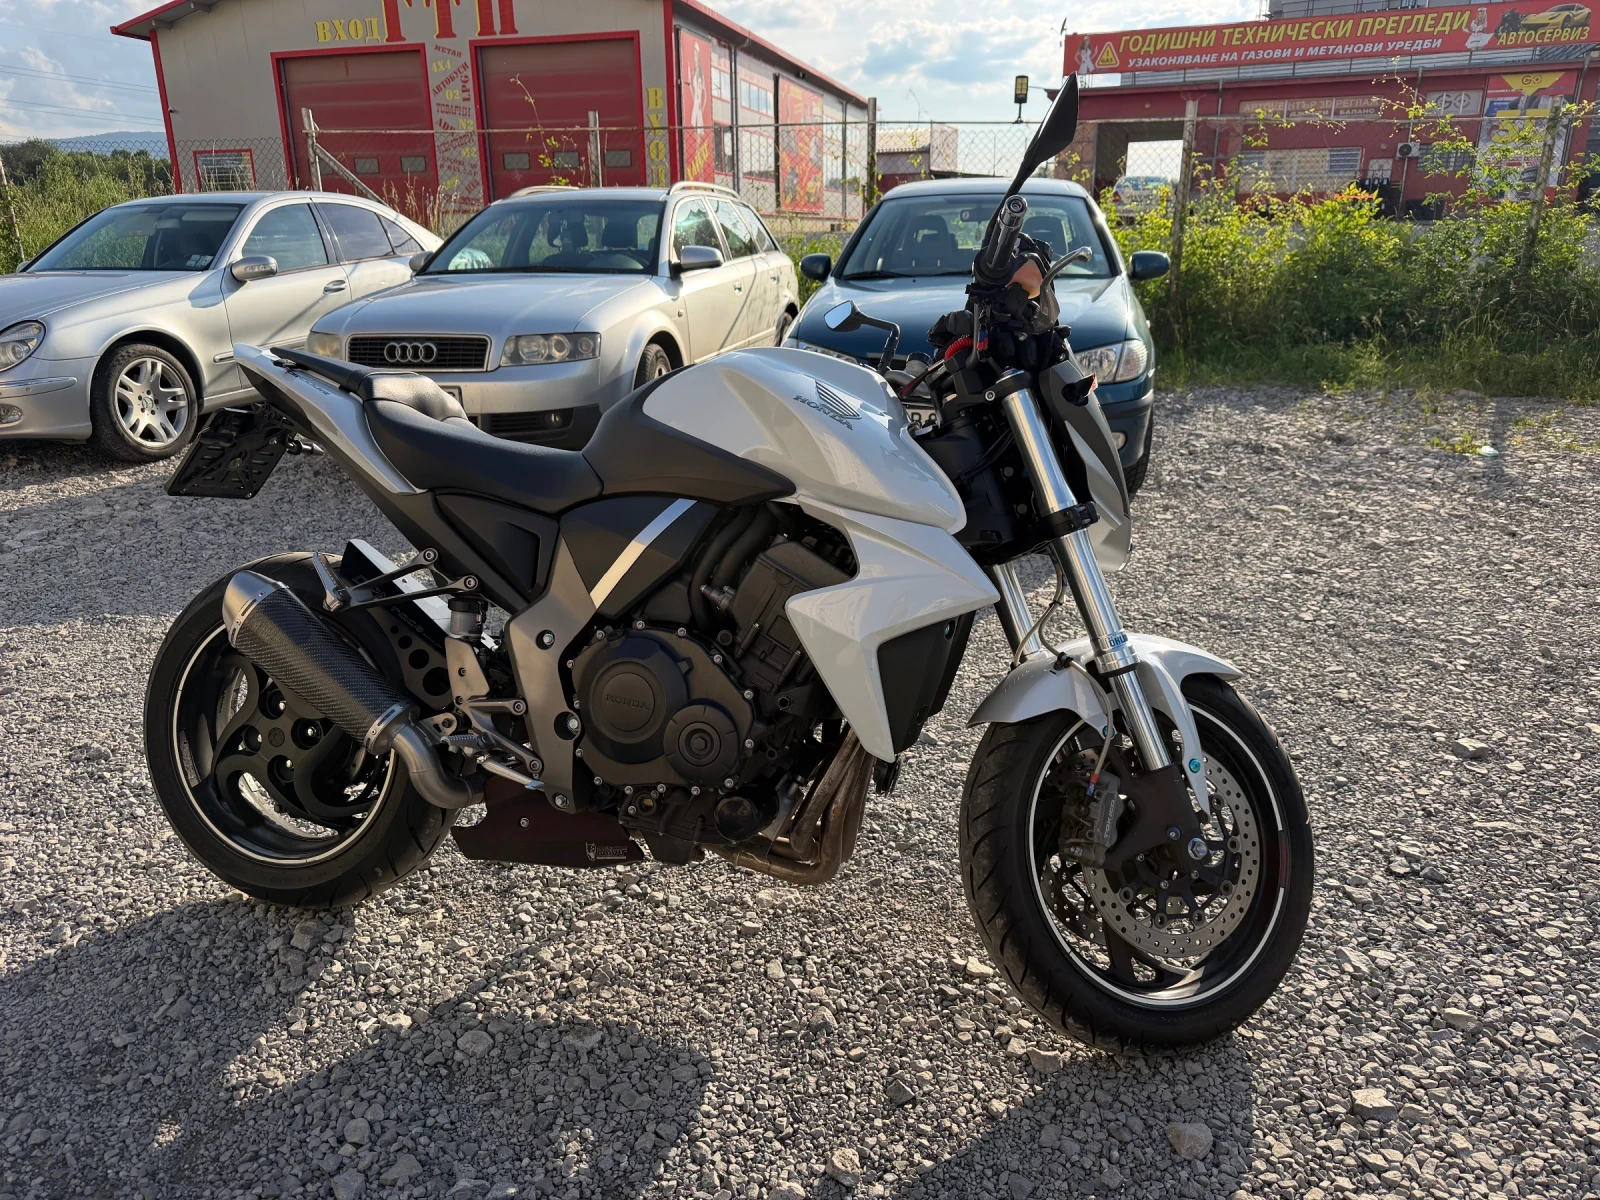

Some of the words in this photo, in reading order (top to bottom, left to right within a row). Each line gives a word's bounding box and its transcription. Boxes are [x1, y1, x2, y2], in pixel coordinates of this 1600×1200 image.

[314, 17, 381, 44] ВХОД
[1119, 29, 1217, 55] ГОДИШНИ
[1222, 19, 1353, 46] ТЕХНИЧЕСКИ
[1356, 10, 1471, 37] ПРЕГЛЕДИ
[1497, 26, 1591, 46] АВТОСЕРВИЗ
[434, 44, 462, 58] МЕТАН
[1128, 53, 1218, 68] УЗАКОНЯВАНЕ
[1220, 51, 1238, 62] НА
[1241, 48, 1292, 60] ГАЗОВИ
[1294, 47, 1304, 57] И
[1306, 42, 1384, 56] МЕТАНОВИ
[1386, 39, 1442, 52] УРЕДБИ
[432, 61, 469, 97] АВТОБУСИ
[460, 75, 471, 102] LPG
[436, 102, 471, 117] ТОВАРНИ
[792, 394, 853, 431] HONDA
[605, 694, 650, 710] HONDA
[1103, 799, 1115, 839] TOKICO
